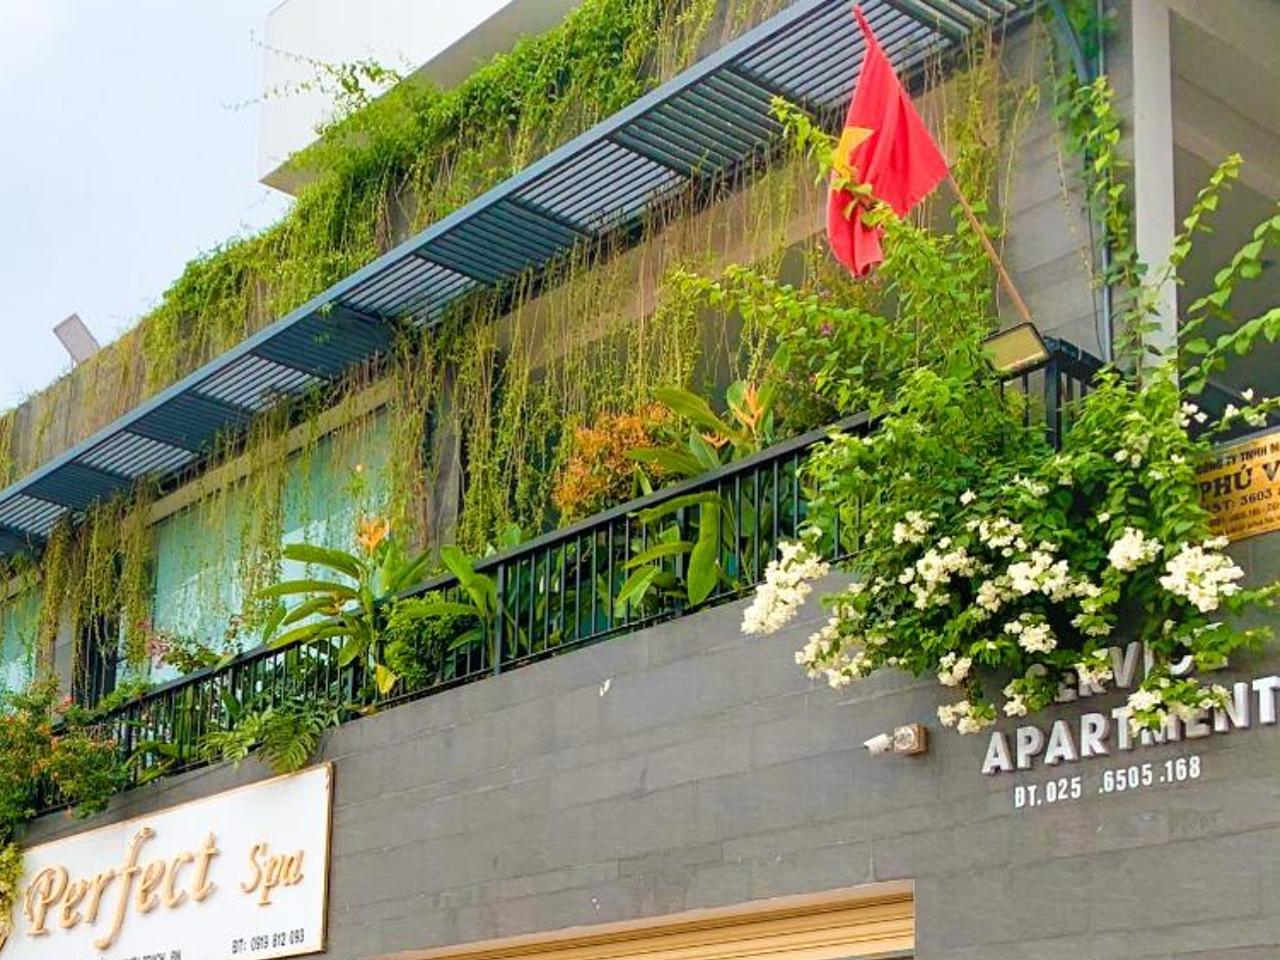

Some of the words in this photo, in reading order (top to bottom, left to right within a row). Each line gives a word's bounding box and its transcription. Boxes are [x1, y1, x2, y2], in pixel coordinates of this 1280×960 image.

[1200, 464, 1253, 501] PHÚ
[24, 826, 220, 950] Perfect
[241, 842, 306, 906] Spa
